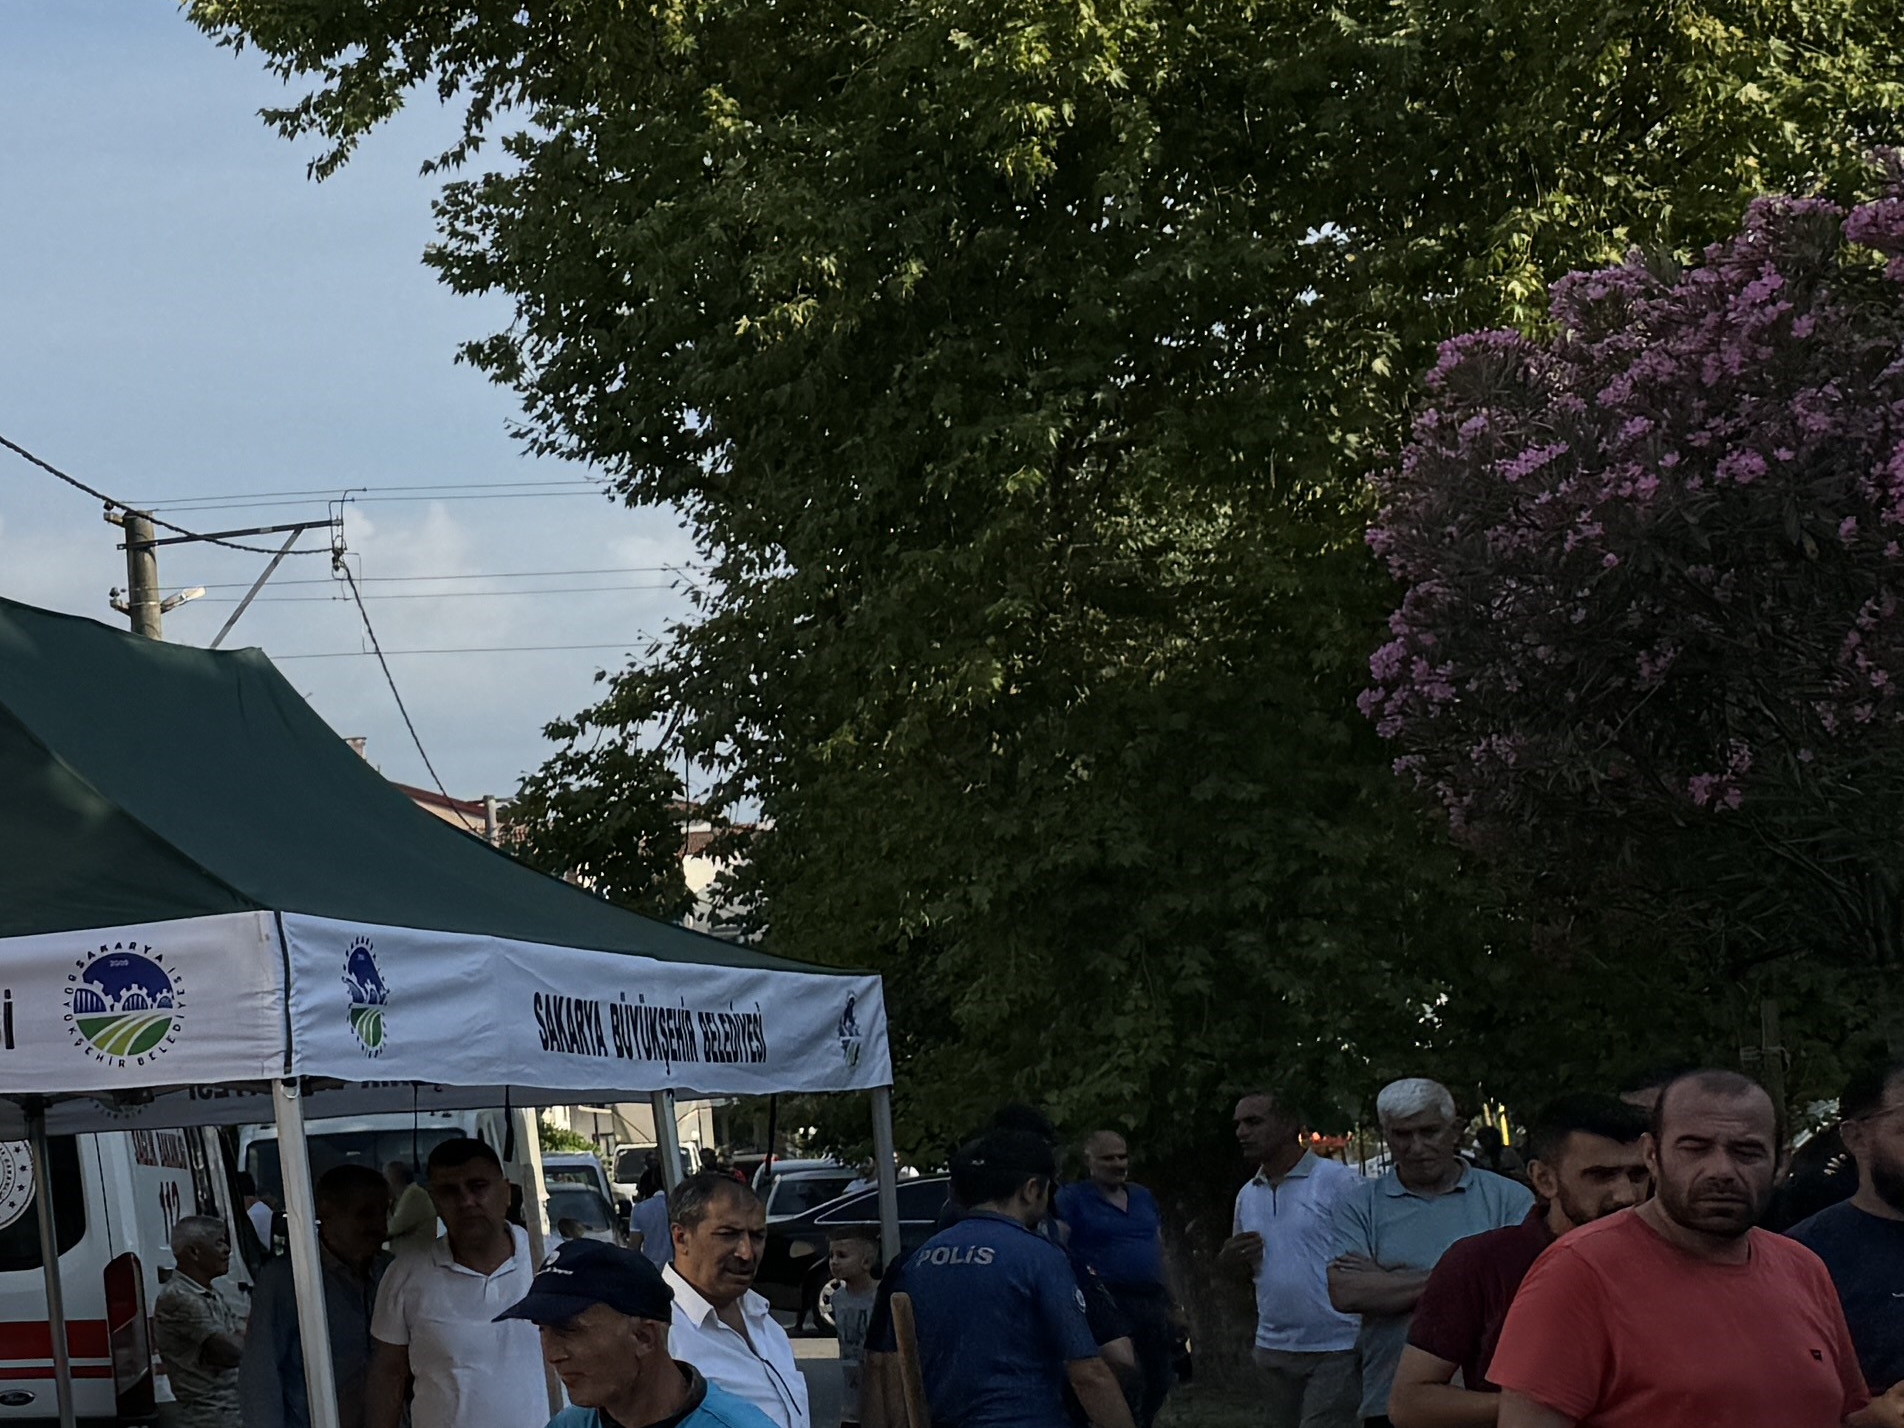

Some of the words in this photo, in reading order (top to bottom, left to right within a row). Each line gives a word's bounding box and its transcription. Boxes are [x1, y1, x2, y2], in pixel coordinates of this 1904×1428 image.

[533, 991, 609, 1058] SAKARYA
[609, 992, 699, 1076] BÜYÜKŞEHİR
[697, 1001, 767, 1063] BELEDİYESİ
[914, 1245, 996, 1268] POLİS
